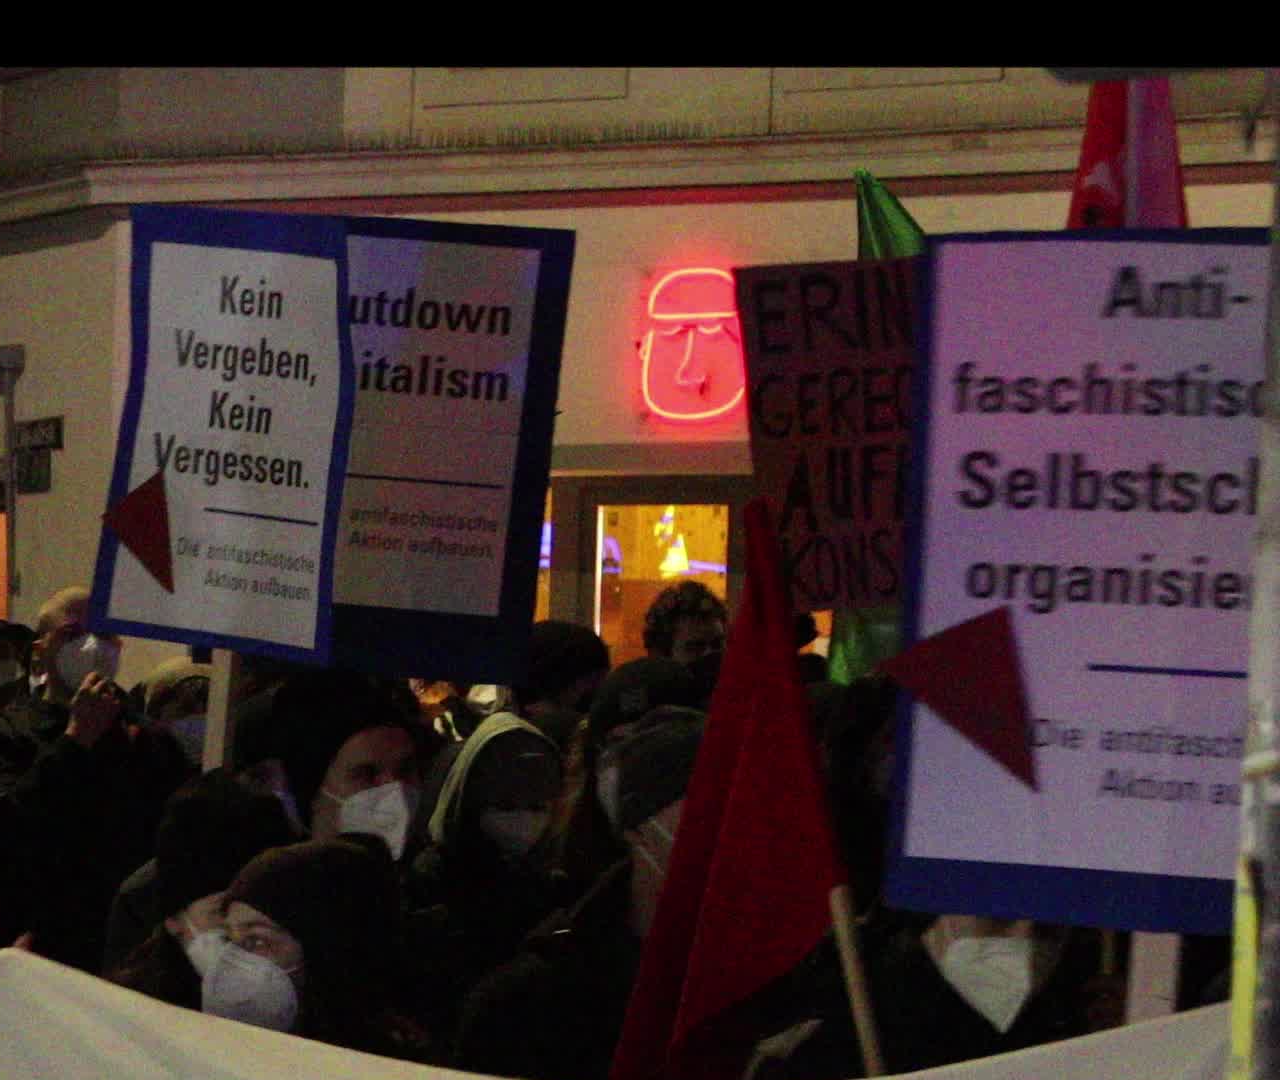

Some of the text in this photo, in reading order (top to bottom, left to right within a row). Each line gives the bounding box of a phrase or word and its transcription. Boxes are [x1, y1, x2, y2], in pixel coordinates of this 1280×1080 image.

[219, 275, 284, 320] Kein
[349, 287, 513, 338] utdown
[1100, 265, 1252, 319] Anti-
[174, 328, 318, 388] Vergeben,
[208, 391, 273, 435] Kein
[153, 432, 311, 491] Vergessen.
